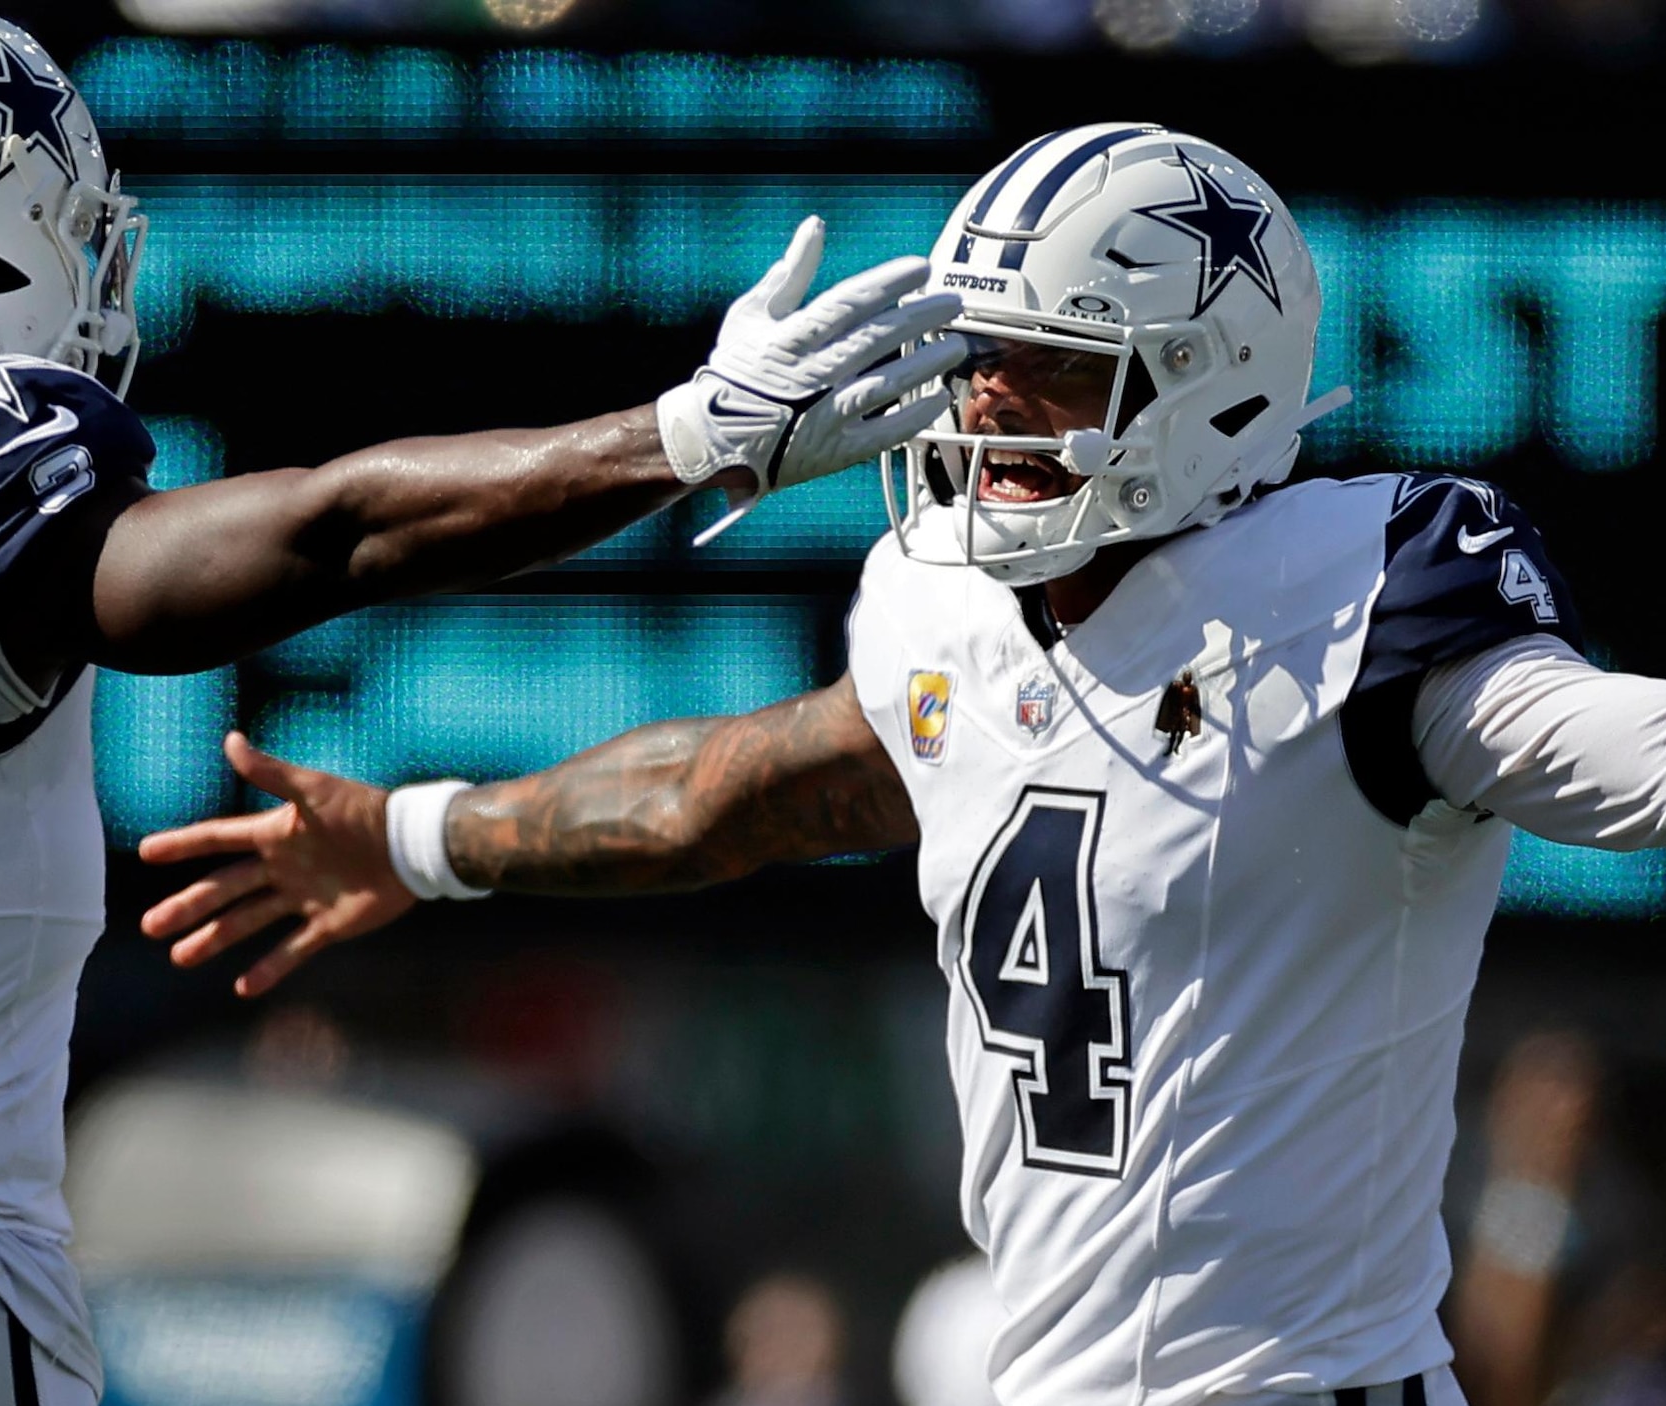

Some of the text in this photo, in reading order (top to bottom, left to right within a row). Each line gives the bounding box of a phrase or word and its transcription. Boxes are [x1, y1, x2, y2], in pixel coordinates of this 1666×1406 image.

[943, 273, 1008, 293] COWBOYS
[29, 444, 95, 515] 3
[1498, 549, 1559, 623] 4
[1020, 701, 1047, 727] NFL
[958, 784, 1133, 1179] 4
